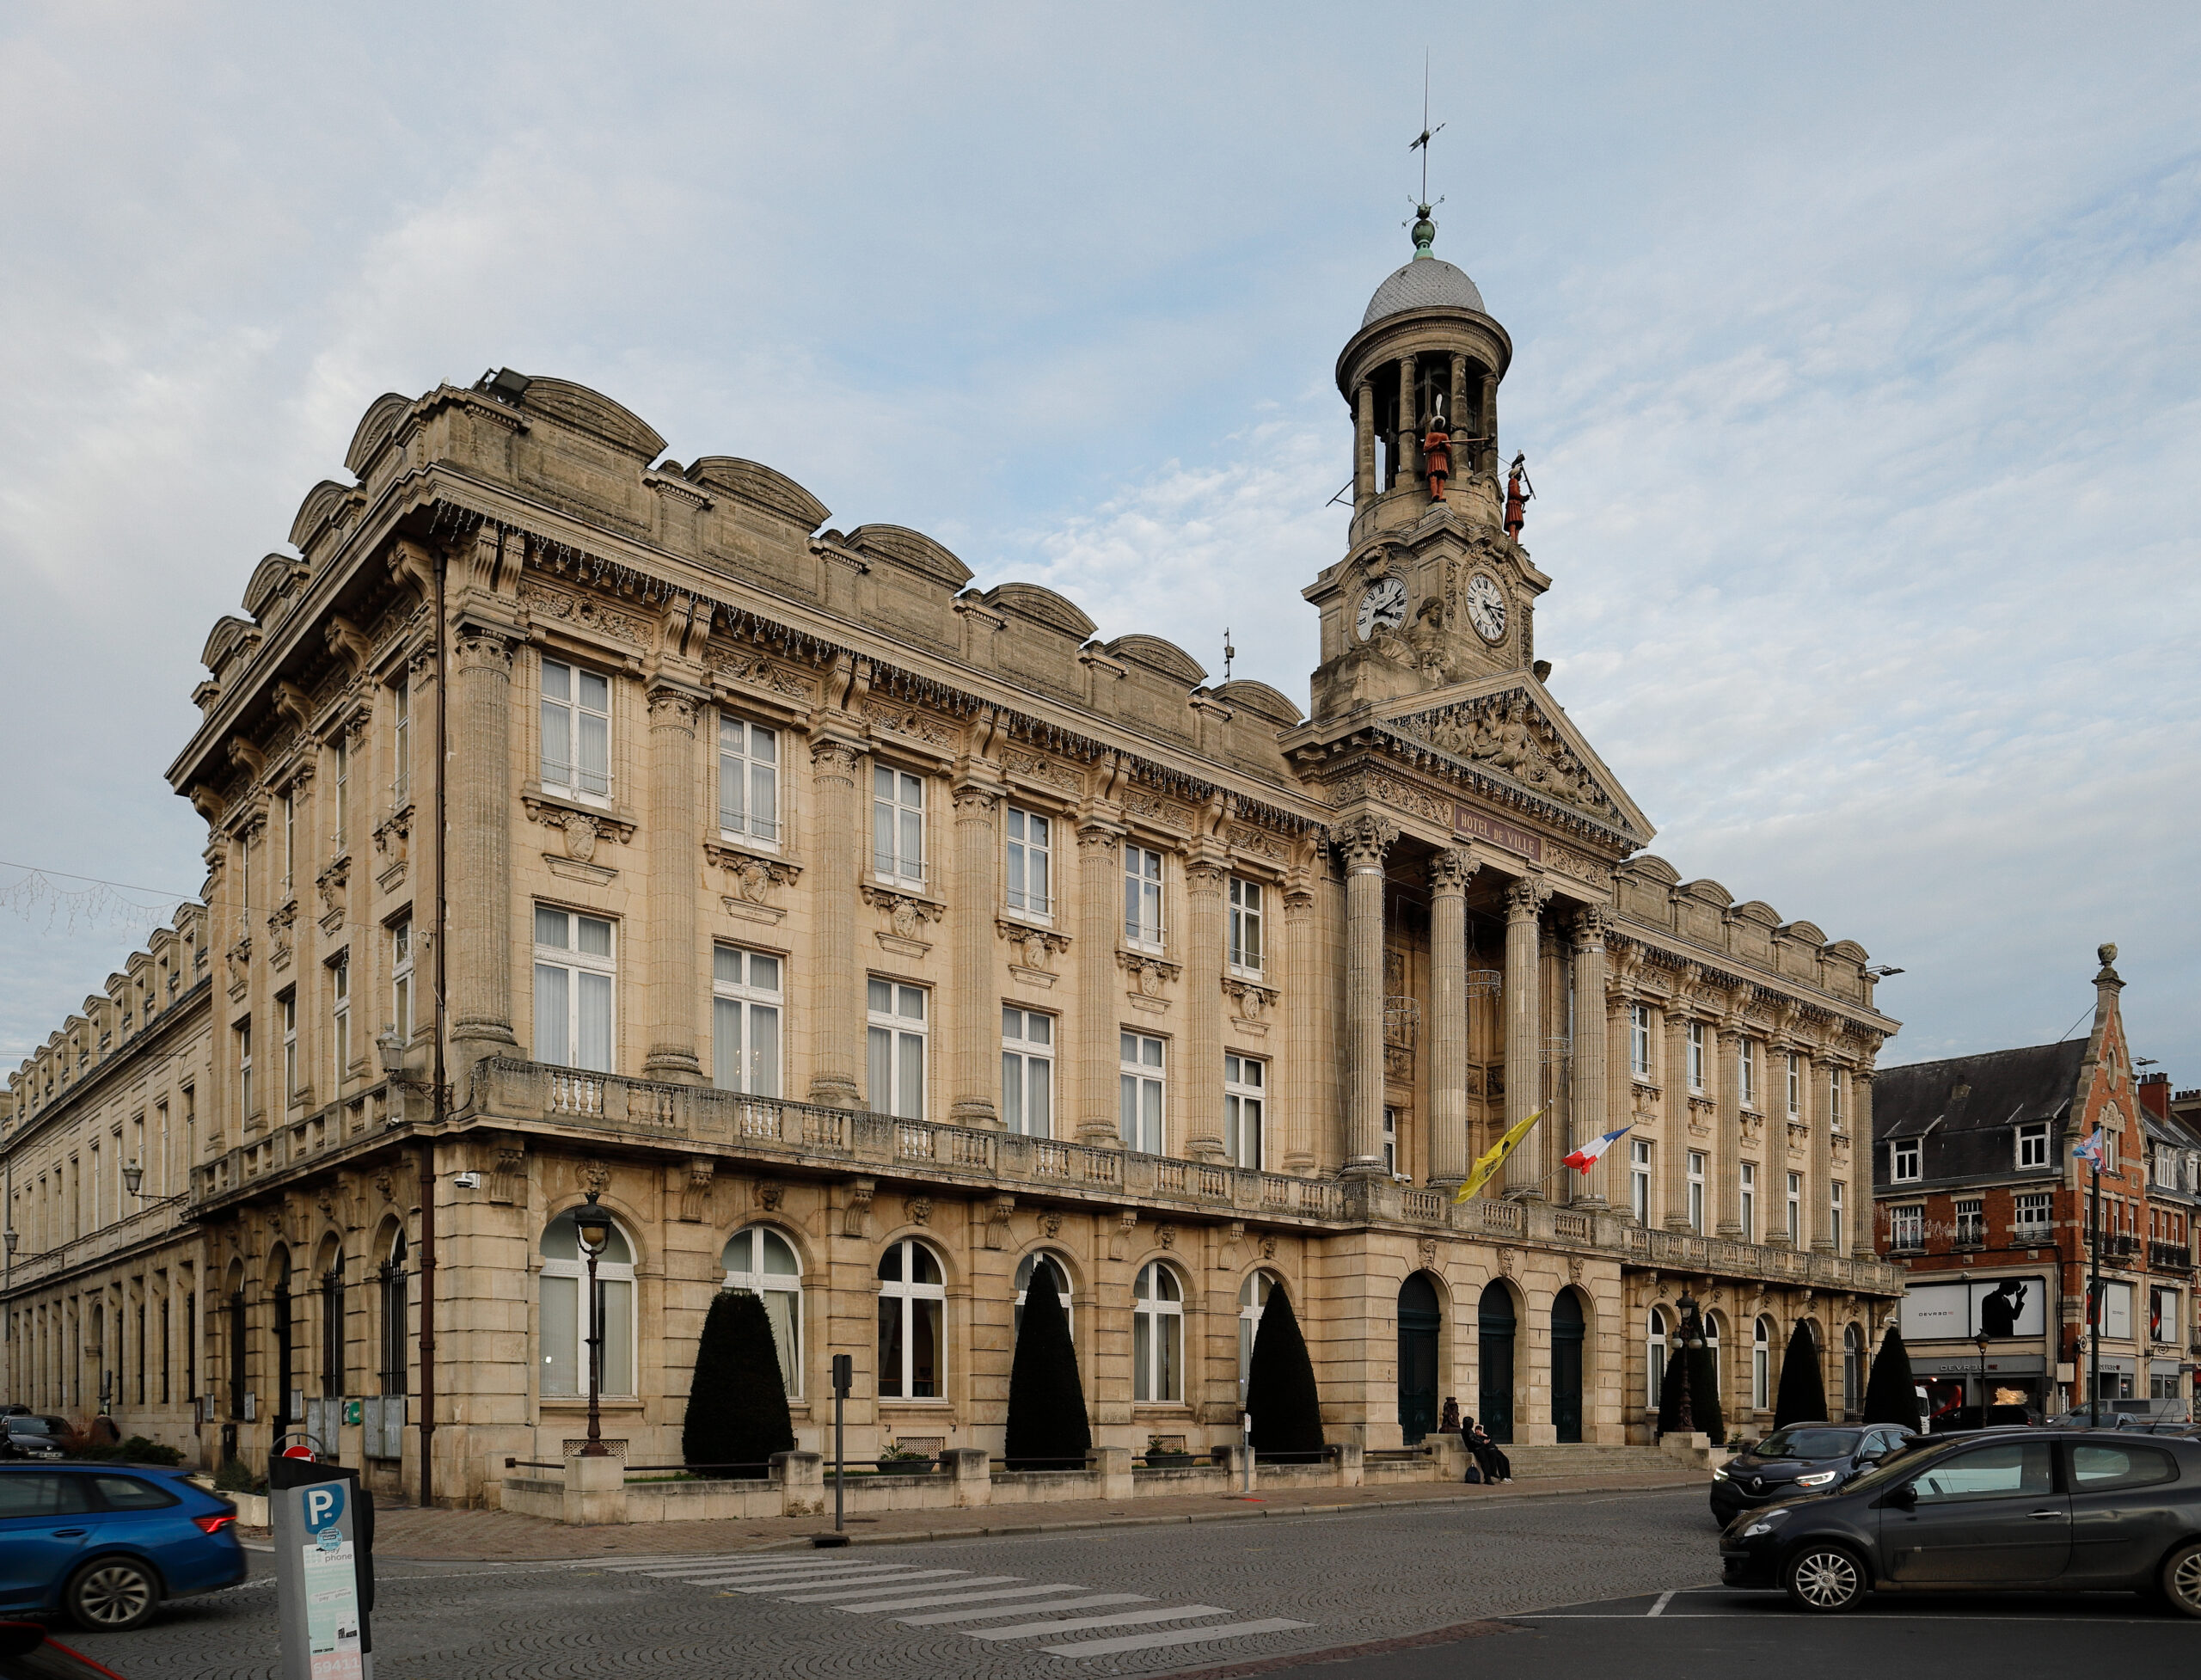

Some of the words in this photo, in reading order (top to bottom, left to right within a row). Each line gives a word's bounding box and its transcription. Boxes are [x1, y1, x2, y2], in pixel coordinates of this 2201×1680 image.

[1461, 812, 1490, 837] HOTEL
[1493, 828, 1503, 842] DE
[1507, 831, 1534, 854] VILLE
[309, 1490, 334, 1525] P
[325, 1554, 353, 1563] phone
